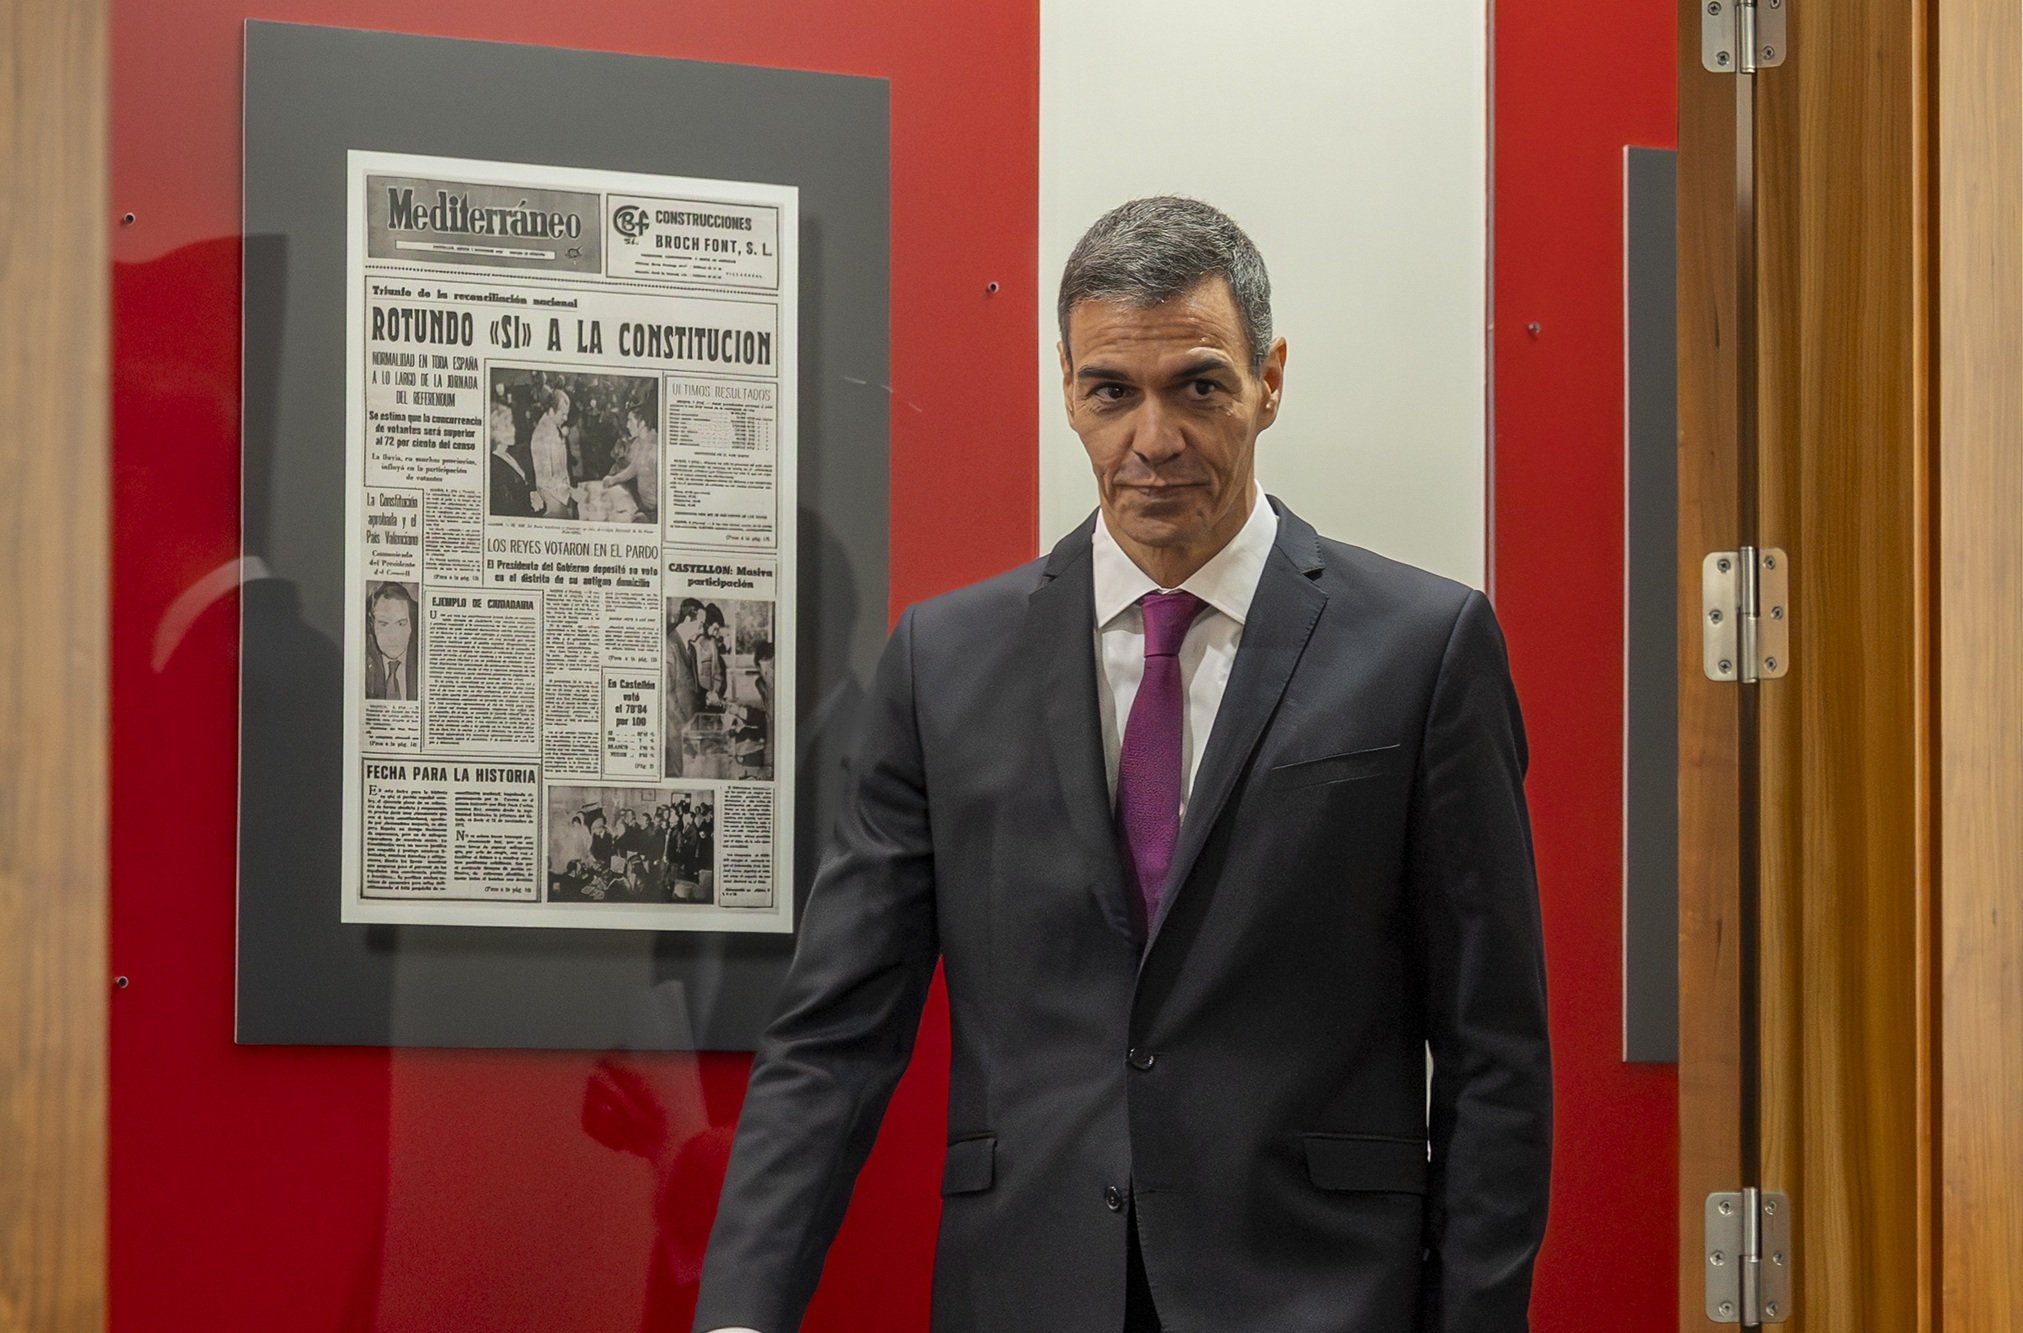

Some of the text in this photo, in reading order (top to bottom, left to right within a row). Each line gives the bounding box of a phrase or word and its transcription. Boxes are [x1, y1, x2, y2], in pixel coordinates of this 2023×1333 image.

[386, 187, 581, 240] Mediterráneo
[656, 210, 752, 231] CONSTRUCCIONES
[656, 235, 699, 251] BROCH
[704, 238, 741, 256] FONT,
[747, 242, 757, 255] S.
[372, 286, 577, 308] Triunfo de la reconciliación nacional
[372, 306, 770, 365] ROTUNDO «SI» A LA CONSTITUCION
[372, 351, 478, 370] NORMALIDAD EN TODA ESPAÑA
[372, 371, 478, 389] A LO LARGO DE LA JORNADA
[396, 391, 455, 407] DEL REFERENDUM
[672, 383, 771, 401] ULTIMOS RESULTADOS
[369, 411, 481, 426] Se estima que la concurrencia
[376, 424, 475, 438] de votantes será superior
[376, 437, 475, 450] al 72 por ciento del censo
[367, 492, 417, 508] La Constitución
[368, 512, 416, 529] aprobada y el
[385, 531, 418, 546] Valenciano
[487, 539, 658, 559] LOS REYES VOTARON EN EL PARDO
[487, 560, 493, 568] El
[497, 560, 538, 571] Presidente
[542, 562, 553, 571] del
[556, 563, 589, 573] Gobierno
[593, 564, 625, 576] depositó
[641, 567, 658, 576] voto
[669, 563, 773, 577] CASTELLON: Masiva
[509, 574, 516, 582] el
[521, 574, 549, 583] distrito
[555, 575, 564, 584] de
[583, 576, 611, 587] antiguo
[616, 578, 650, 587] domicilio
[688, 577, 754, 588] participación
[433, 597, 534, 610] EJEMPLO DE CIUDADANIA
[608, 679, 655, 689] En Castellón
[623, 693, 640, 701] votó
[615, 705, 622, 713] el
[616, 717, 646, 727] por 100
[367, 765, 535, 784] FECHA PARA LA HISTORIA
